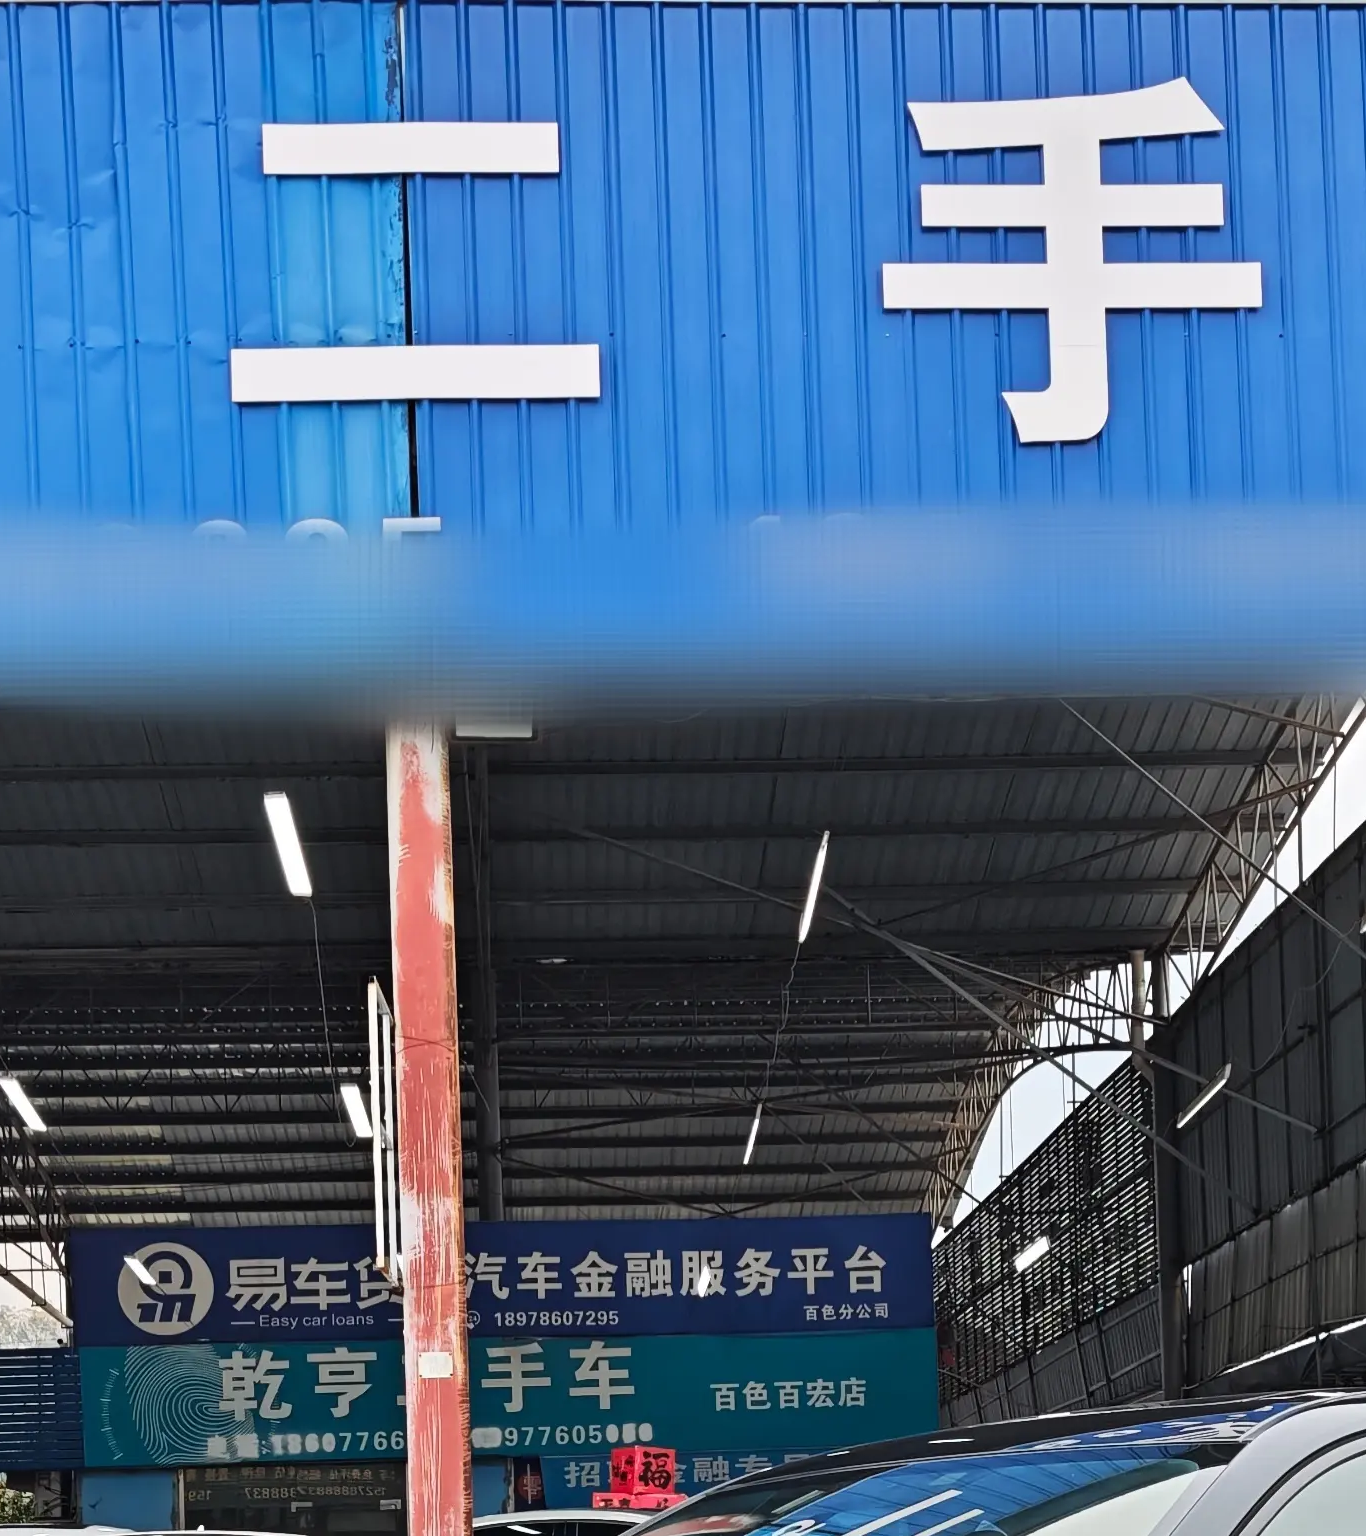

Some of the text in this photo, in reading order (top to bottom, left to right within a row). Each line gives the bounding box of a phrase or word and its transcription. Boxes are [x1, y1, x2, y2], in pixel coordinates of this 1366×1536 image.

[494, 1311, 619, 1327] 18978607295
[803, 1303, 889, 1321] 百色分公司
[259, 1314, 374, 1330] Easy car loans
[710, 1378, 867, 1411] 百色百宏店
[639, 1450, 672, 1490] 福
